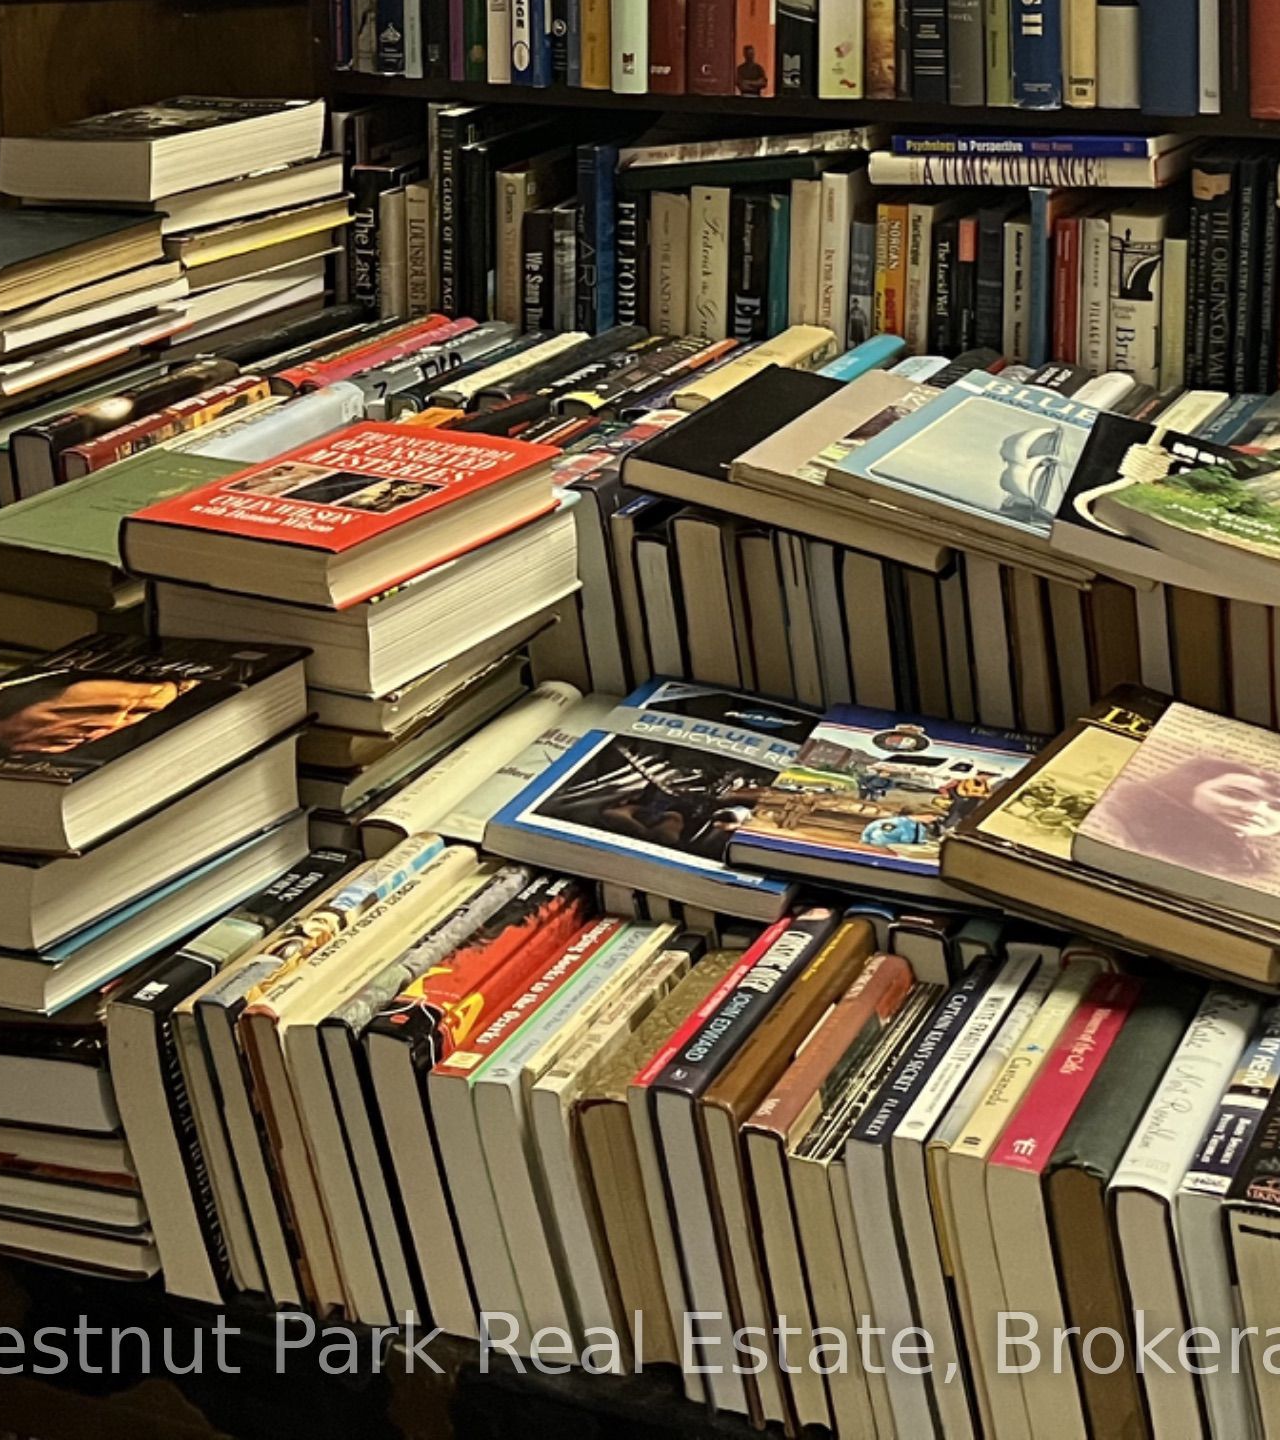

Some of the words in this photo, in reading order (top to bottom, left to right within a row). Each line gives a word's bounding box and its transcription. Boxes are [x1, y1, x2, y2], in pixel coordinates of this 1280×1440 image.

[1021, 13, 1043, 35] II
[941, 157, 992, 185] TIME
[1029, 157, 1099, 186] DANCE
[356, 208, 374, 245] The
[355, 249, 373, 288] Last
[526, 252, 543, 271] We
[618, 201, 635, 328] FULFORD
[526, 275, 542, 304] Sang
[1210, 248, 1228, 321] ORIGINS
[982, 380, 1098, 421] BLUE
[301, 448, 474, 484] MYSTERIES
[632, 721, 662, 736] OF
[663, 725, 754, 758] BICYCLE
[639, 713, 683, 731] BIG
[687, 719, 763, 745] BLUE
[728, 993, 753, 1017] JOHN
[929, 994, 967, 1030] CAPTAIN
[684, 1012, 733, 1062] EDWARD
[891, 1060, 924, 1093] SECRET
[1241, 1055, 1278, 1086] HERO
[864, 1098, 898, 1137] FLANKER
[188, 1141, 233, 1281] ROBERTSON
